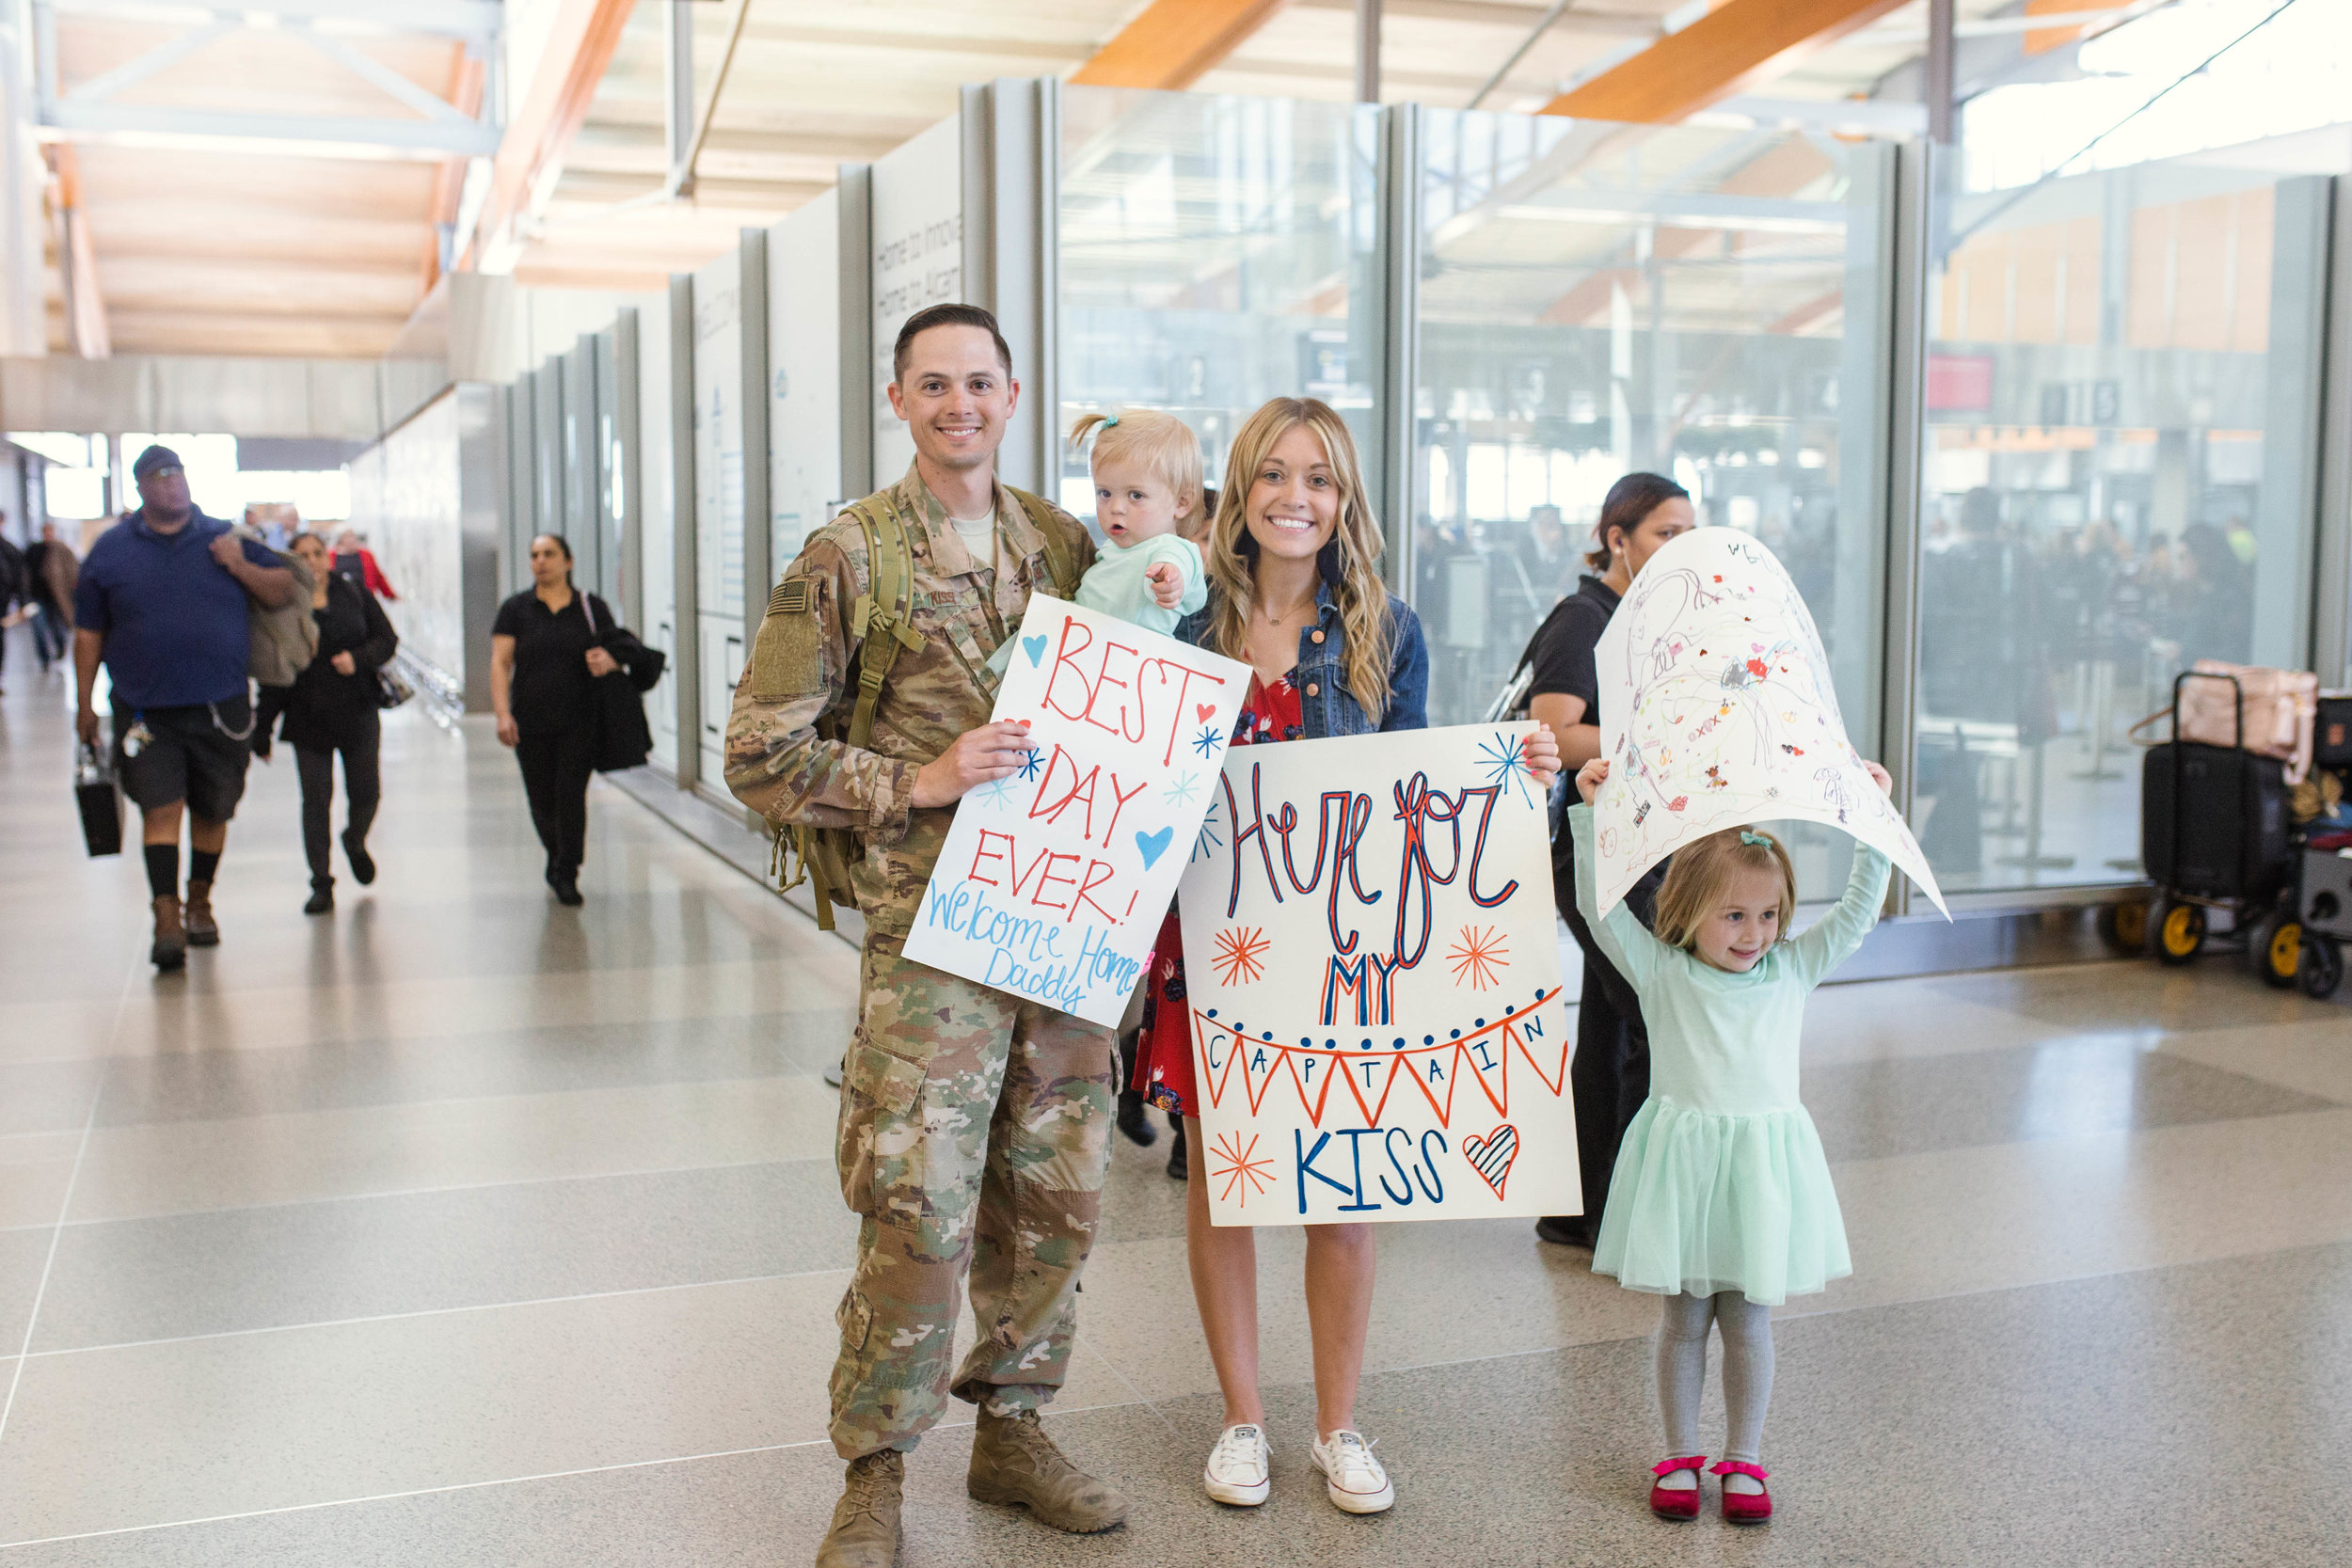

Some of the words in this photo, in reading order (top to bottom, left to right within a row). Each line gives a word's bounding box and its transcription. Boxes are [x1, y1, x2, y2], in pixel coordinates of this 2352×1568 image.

[1041, 615, 1226, 767] BEST
[1028, 743, 1149, 848] DAY
[967, 828, 1140, 926] EVER!
[1220, 761, 1382, 956] Here
[1392, 771, 1519, 969] for
[928, 878, 1064, 962] Welcome
[1069, 925, 1141, 996] Home
[983, 947, 1088, 1014] Daddy
[1319, 952, 1402, 1026] MY
[1208, 1015, 1543, 1088] CAPTAIN
[1295, 1127, 1448, 1214] KISS
